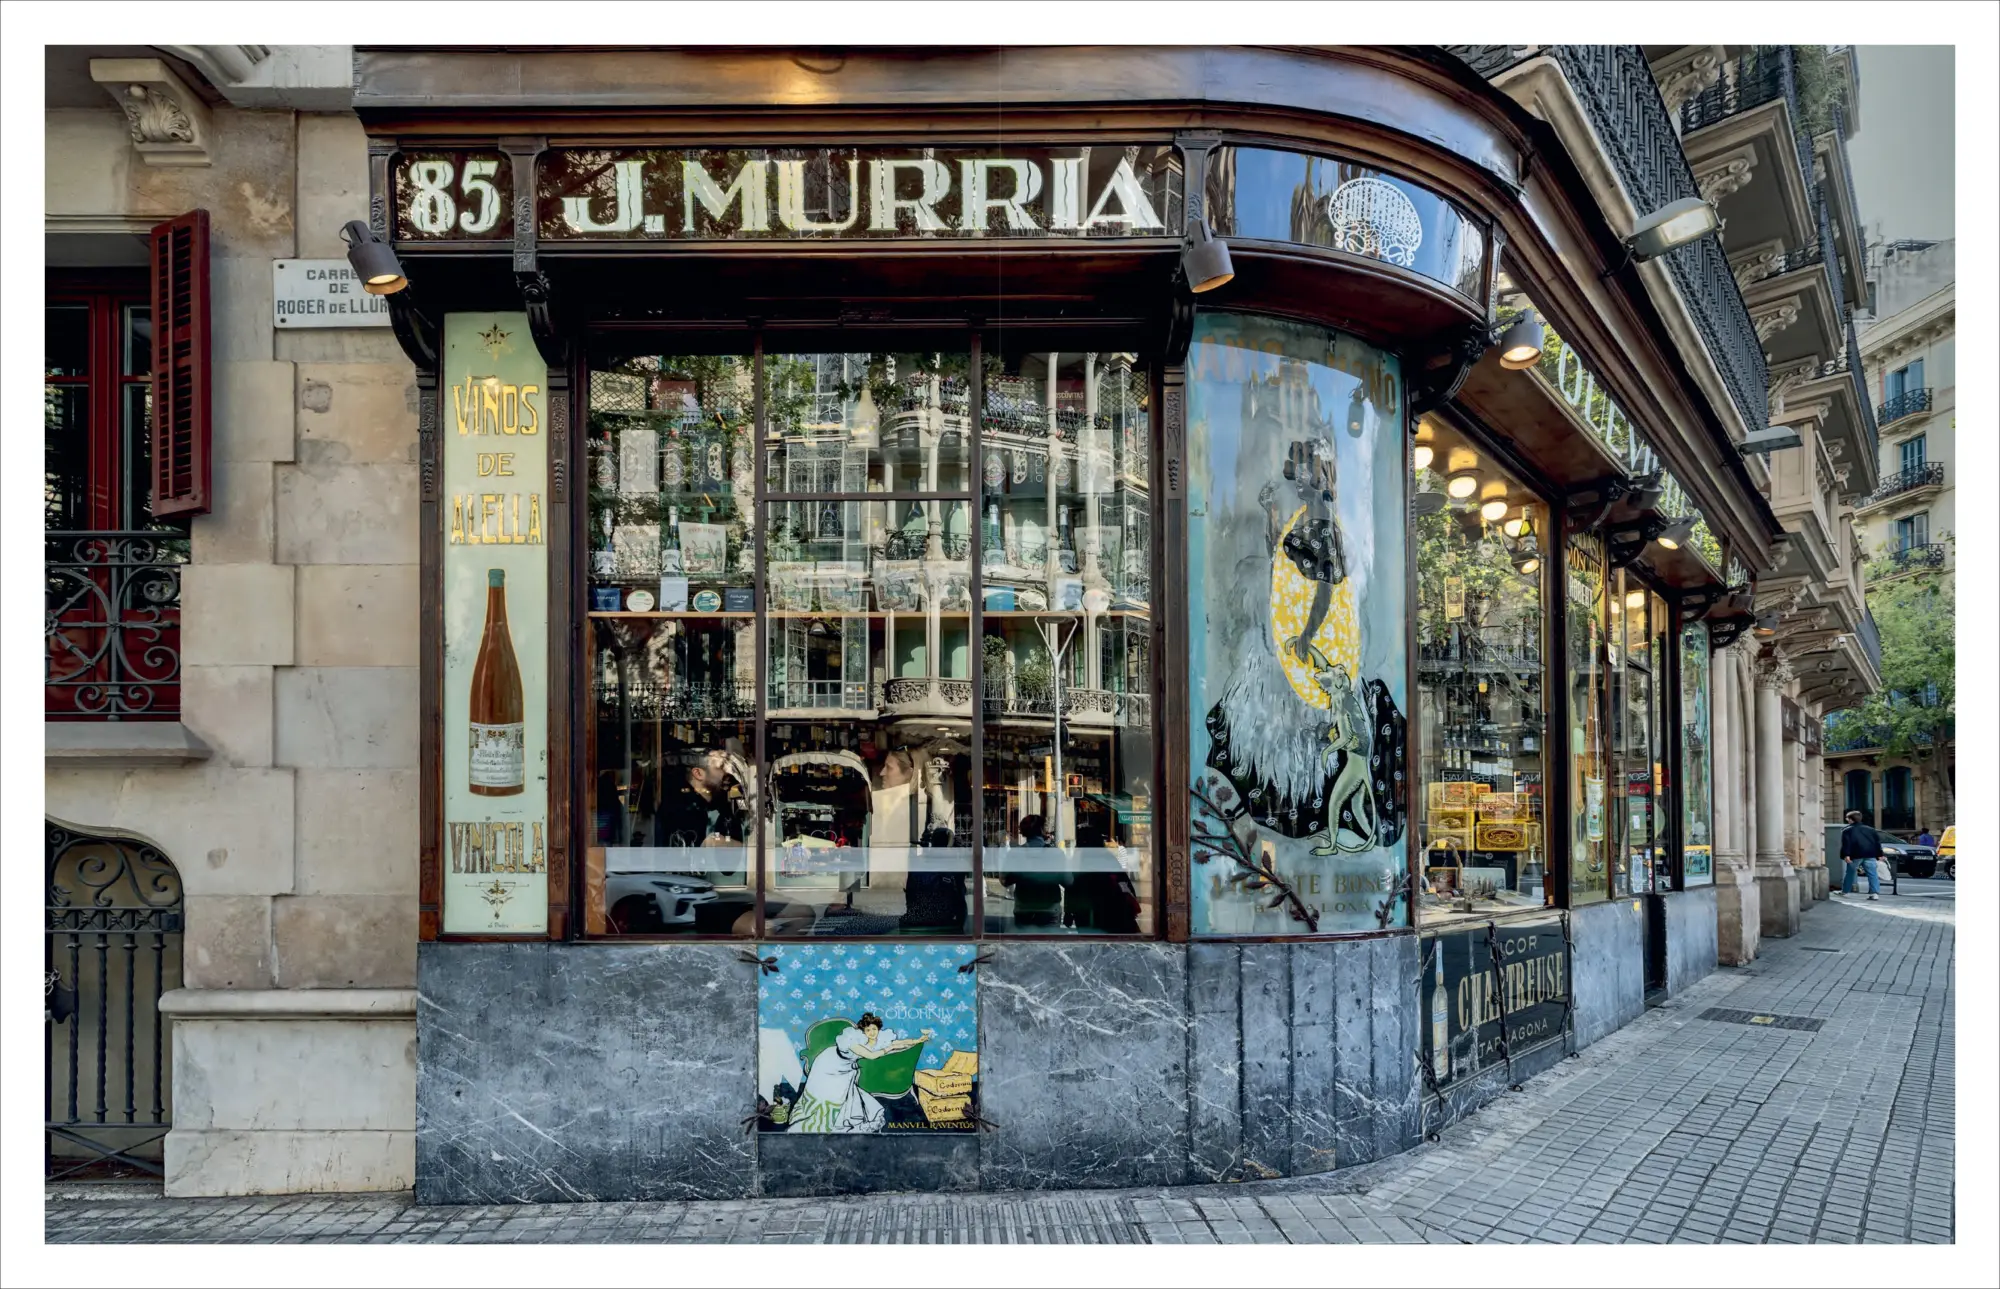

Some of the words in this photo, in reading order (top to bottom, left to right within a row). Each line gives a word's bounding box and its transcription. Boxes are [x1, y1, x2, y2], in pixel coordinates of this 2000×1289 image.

[408, 159, 502, 234] 85
[306, 269, 360, 280] CARRE
[329, 283, 350, 294] DE
[277, 299, 326, 315] ROGER
[350, 293, 388, 314] LLÚR
[477, 452, 515, 477] DE
[450, 494, 544, 546] ALELLA
